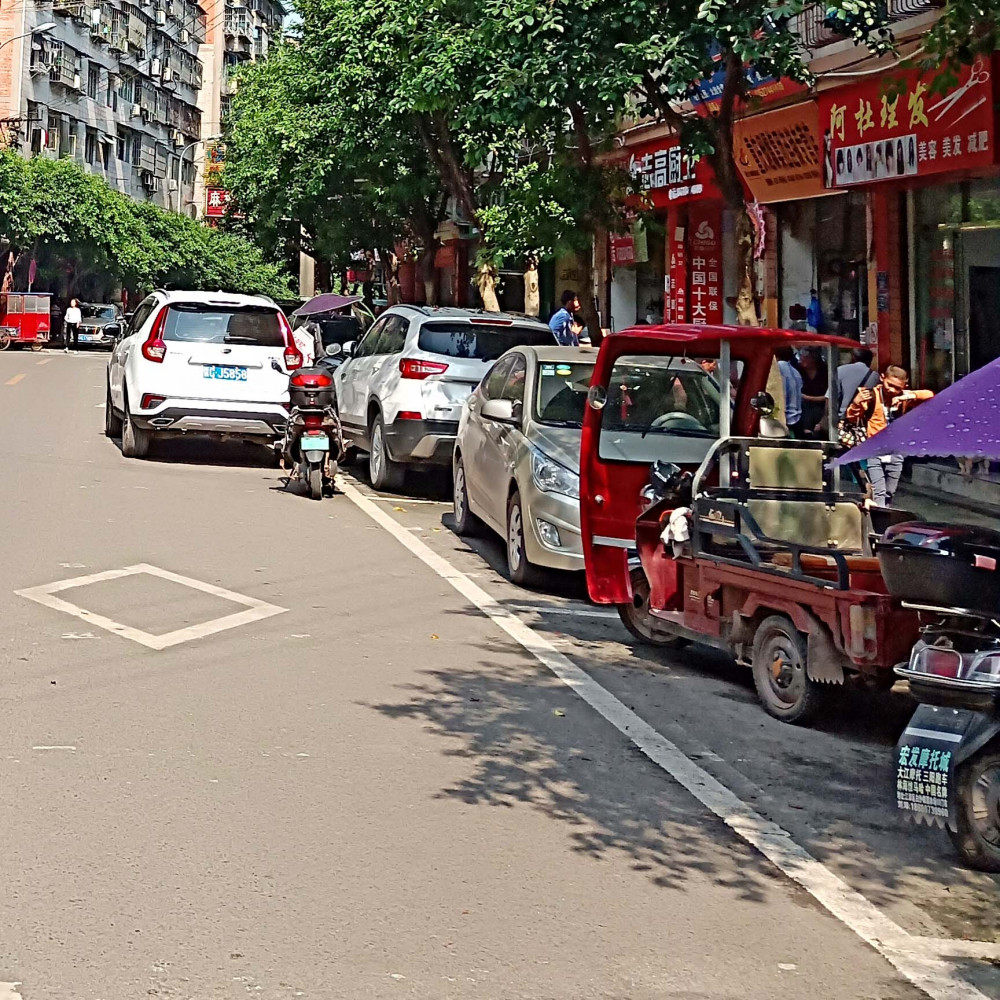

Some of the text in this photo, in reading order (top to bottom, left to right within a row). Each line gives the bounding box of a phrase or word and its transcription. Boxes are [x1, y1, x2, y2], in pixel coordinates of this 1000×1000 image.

[830, 81, 929, 141] 阿杜理发
[918, 130, 989, 162] 美容 美发 减肥
[708, 258, 718, 311] 全国联保
[899, 745, 951, 772] 宏发摩托城
